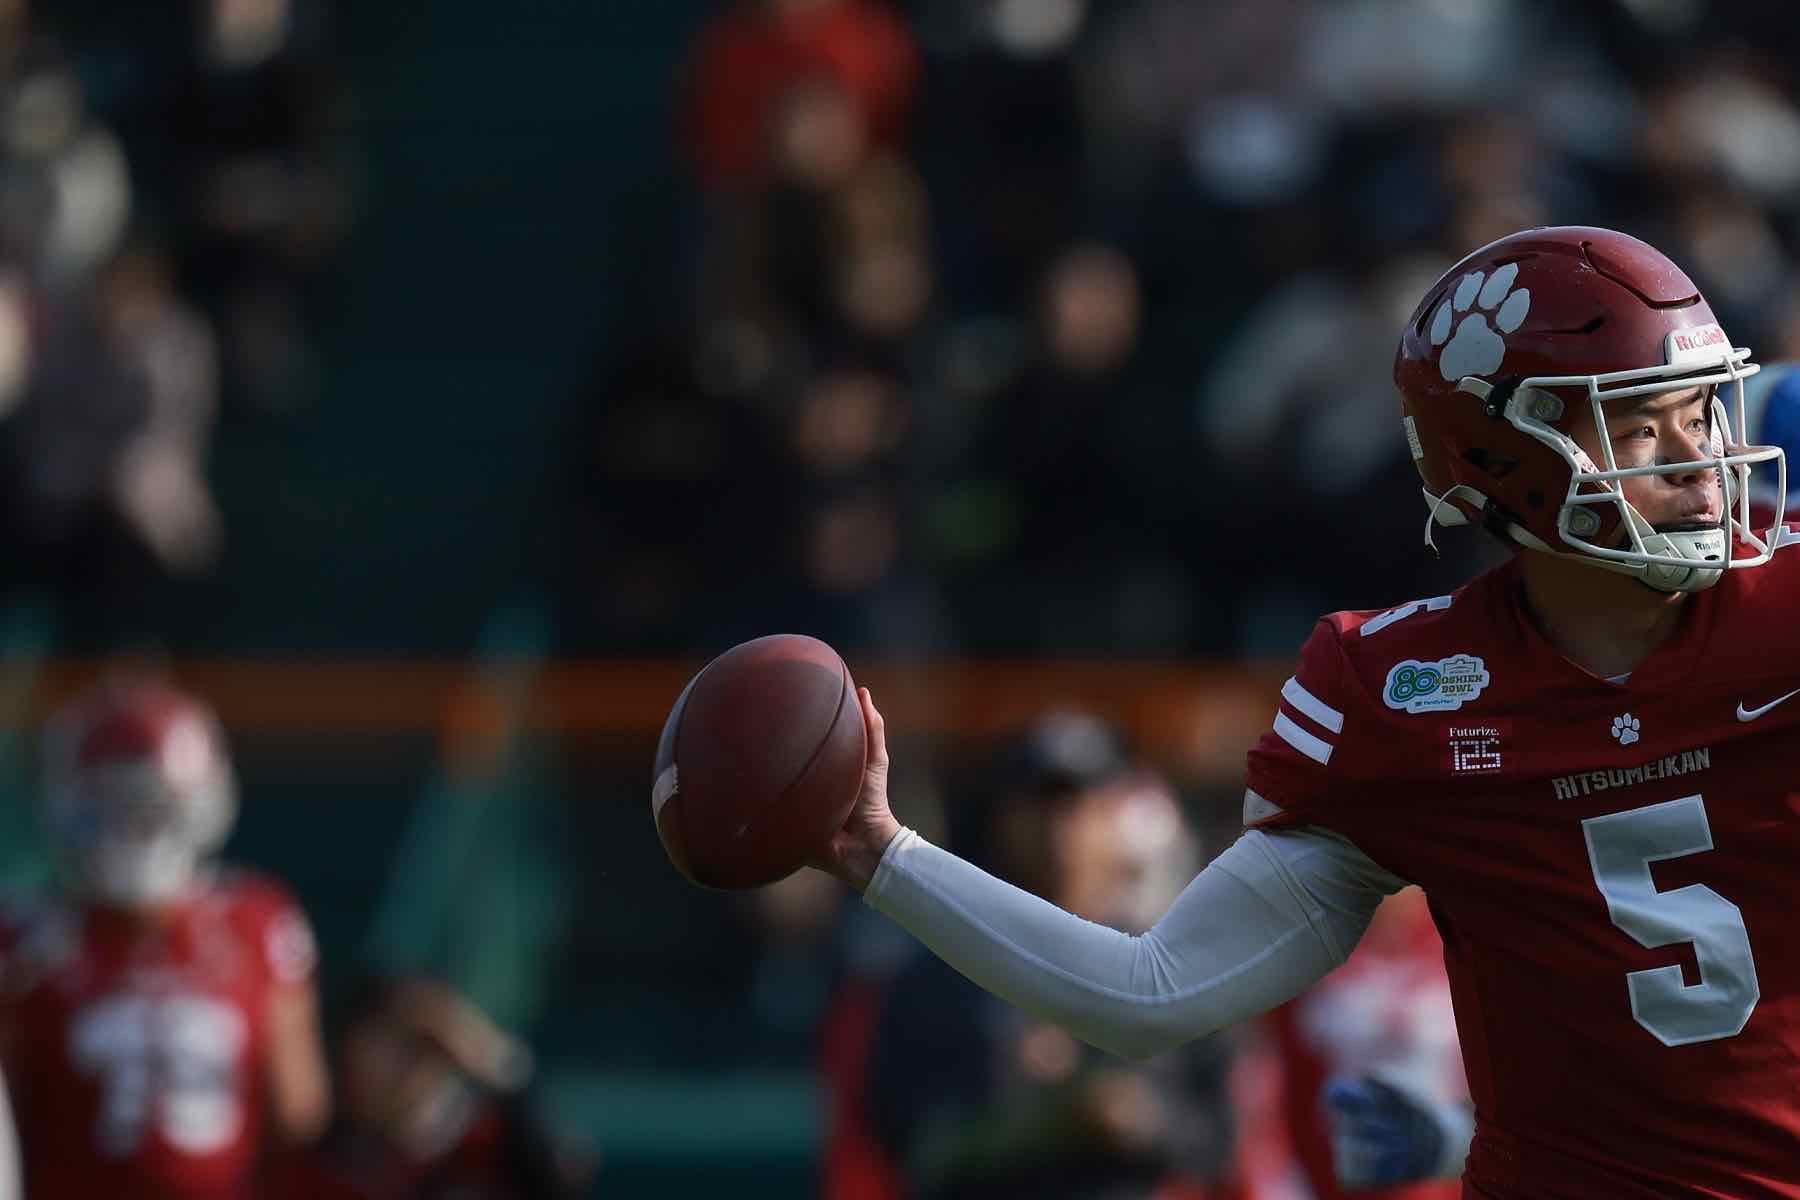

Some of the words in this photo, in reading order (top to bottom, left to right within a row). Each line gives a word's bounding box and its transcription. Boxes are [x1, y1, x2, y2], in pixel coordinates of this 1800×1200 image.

[1448, 725, 1501, 738] Futurize.
[1551, 747, 1712, 800] RITSUMEIKAN
[1581, 793, 1761, 1047] 5
